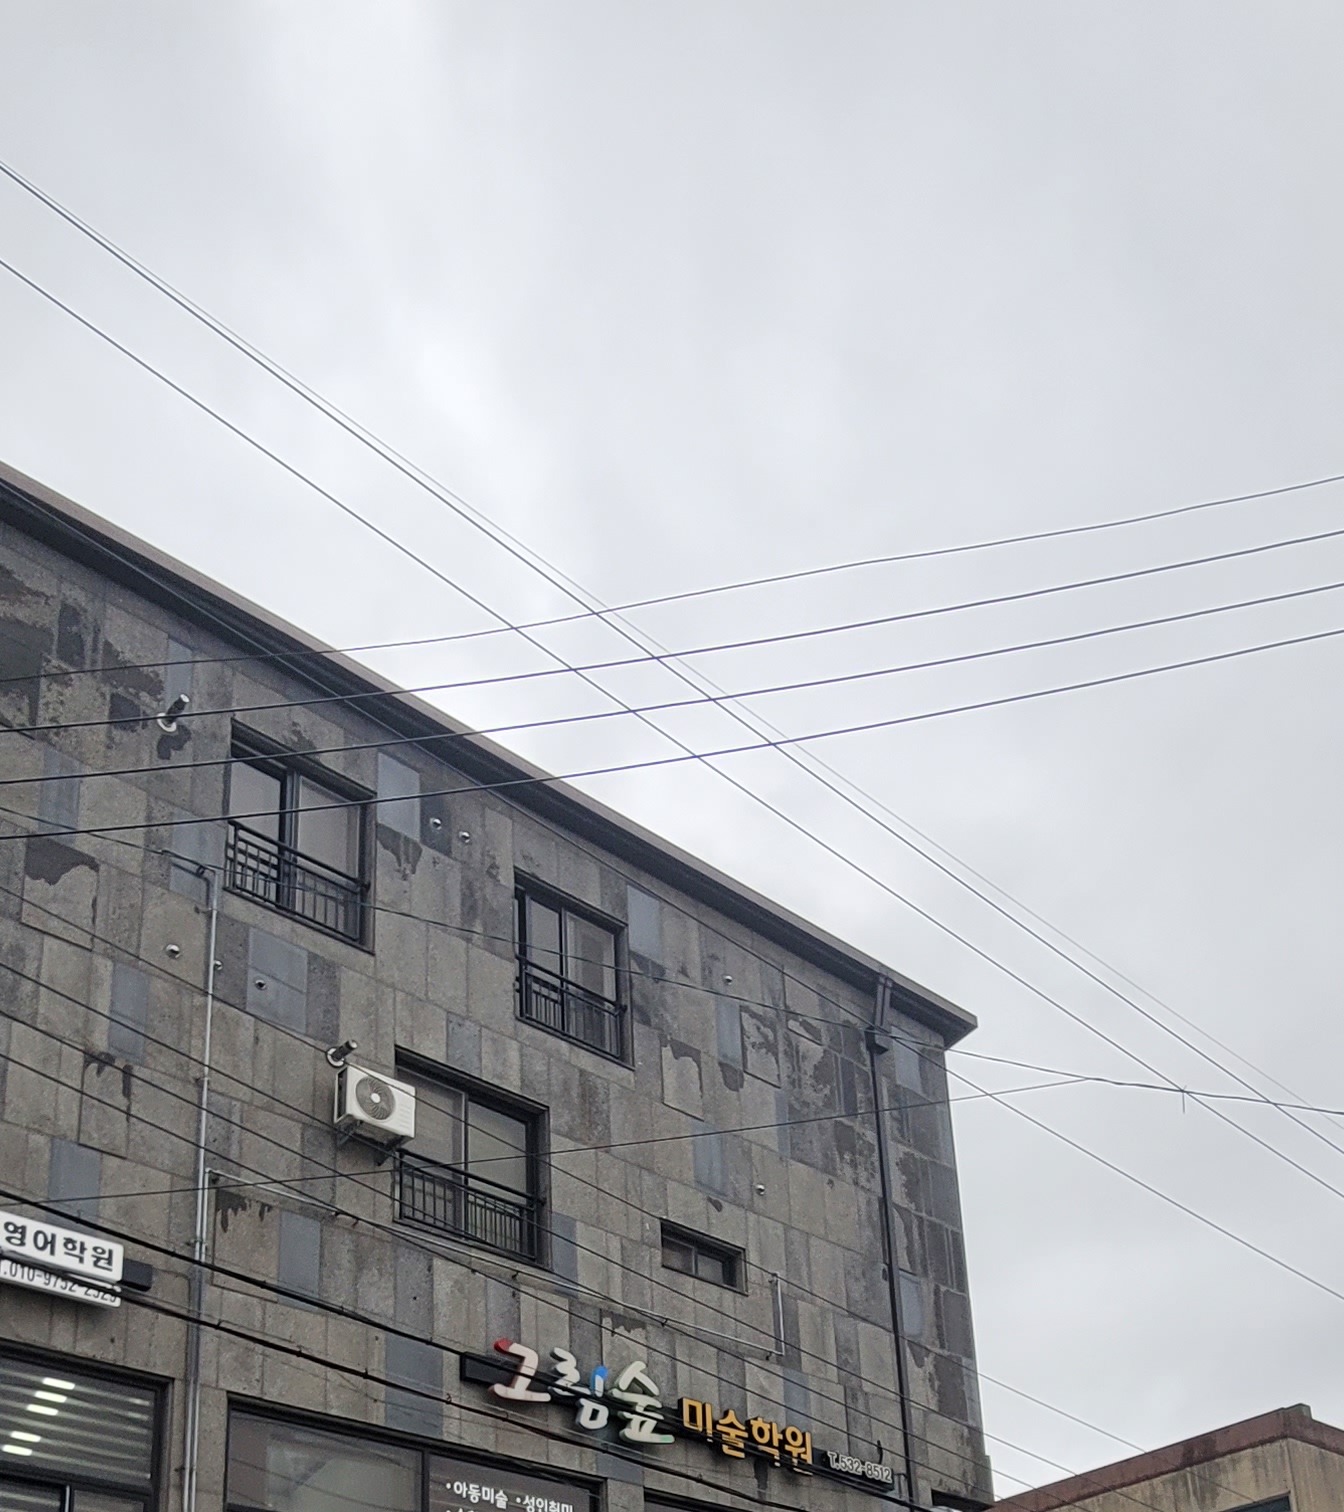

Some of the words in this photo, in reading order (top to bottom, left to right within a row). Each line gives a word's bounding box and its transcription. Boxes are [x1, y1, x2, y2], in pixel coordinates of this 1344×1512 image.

[3, 1221, 114, 1273] 영어학원
[488, 1338, 676, 1445] 그림숲
[681, 1396, 814, 1476] 미술학원
[826, 1450, 894, 1484] T.532-8512
[453, 1481, 509, 1510] 아동미술
